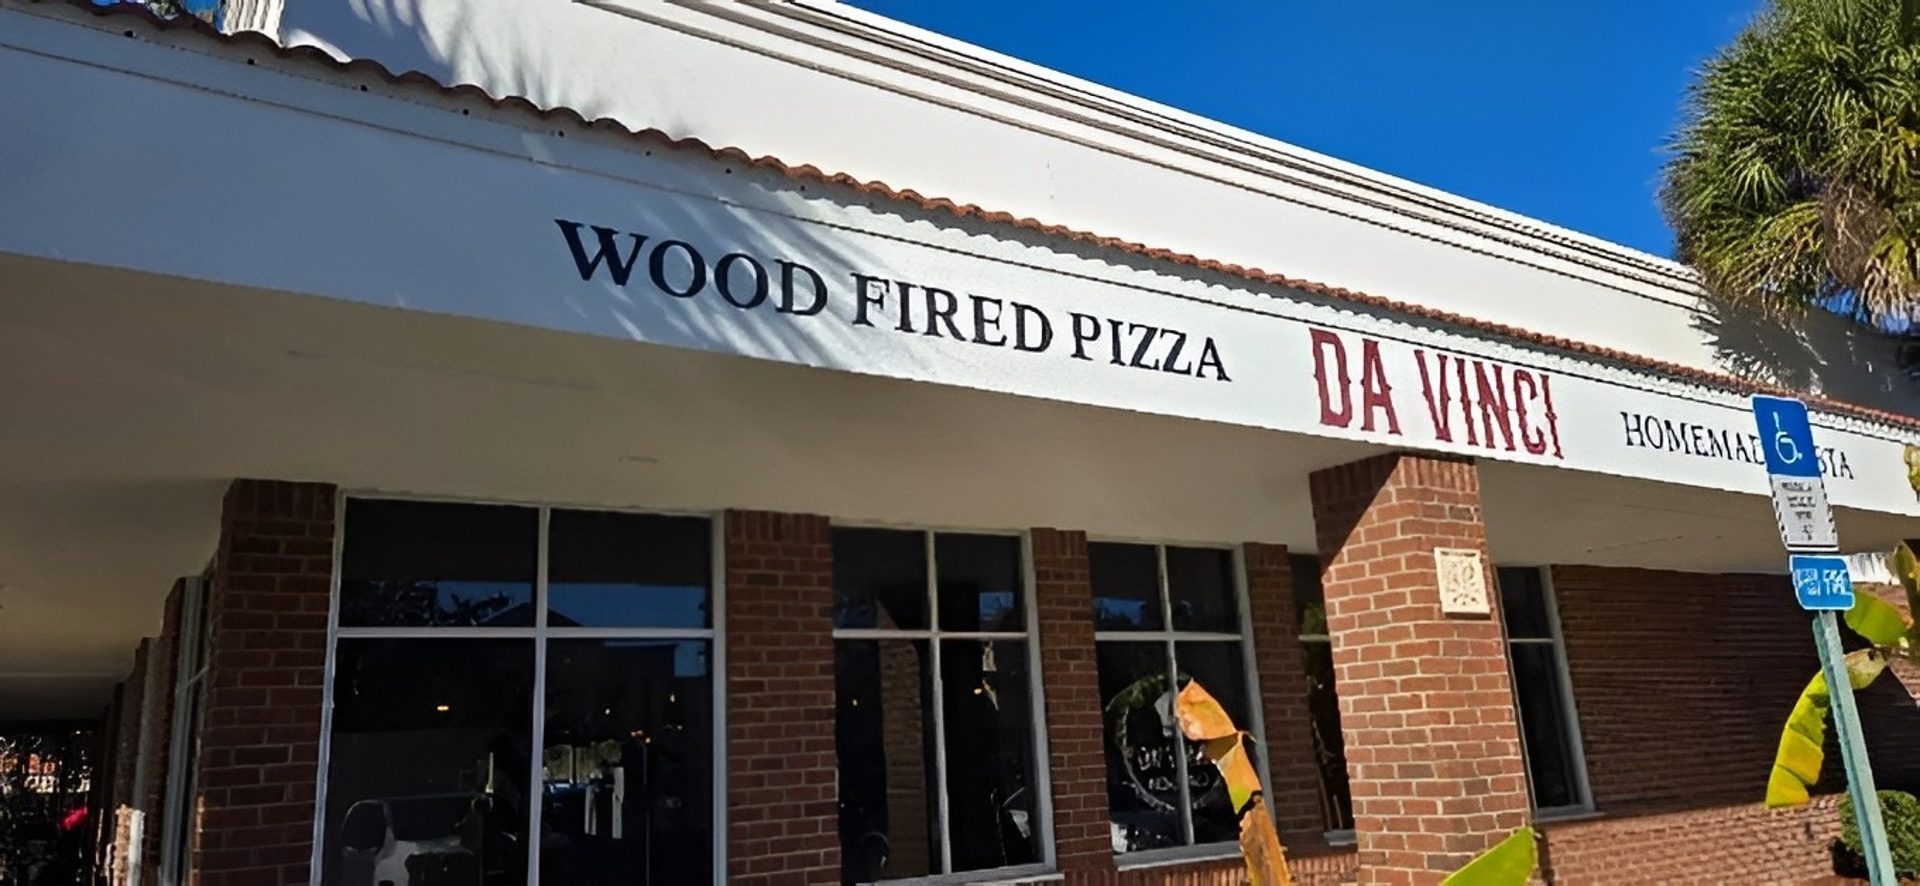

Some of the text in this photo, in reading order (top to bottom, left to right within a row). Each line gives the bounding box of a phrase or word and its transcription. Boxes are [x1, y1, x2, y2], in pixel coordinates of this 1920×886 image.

[555, 219, 1231, 383] WOOD FIRED PIZZA
[1309, 327, 1564, 460] DA VINCI
[1620, 411, 1766, 465] HOMEMAD
